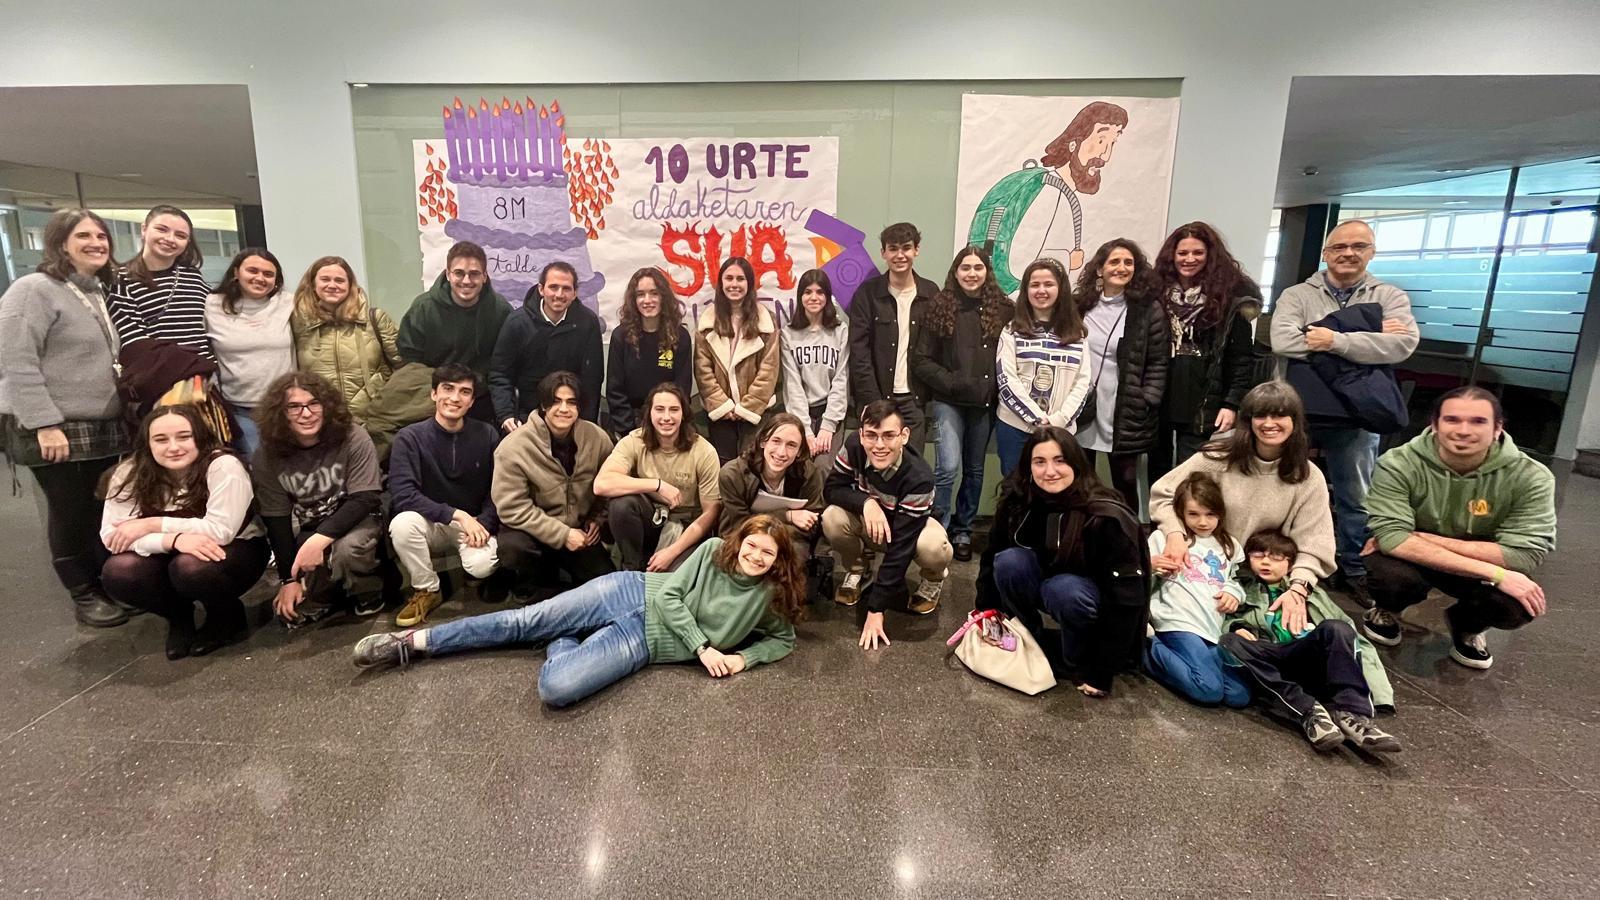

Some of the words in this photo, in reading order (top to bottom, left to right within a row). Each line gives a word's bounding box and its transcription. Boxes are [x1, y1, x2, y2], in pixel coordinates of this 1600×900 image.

[645, 144, 689, 184] 10
[706, 142, 810, 179] URTE
[493, 196, 525, 220] 8M
[633, 179, 808, 221] aldaketaren
[488, 254, 541, 274] talde
[655, 221, 797, 297] SUA
[1479, 258, 1489, 271] 6
[790, 345, 840, 368] OSTON
